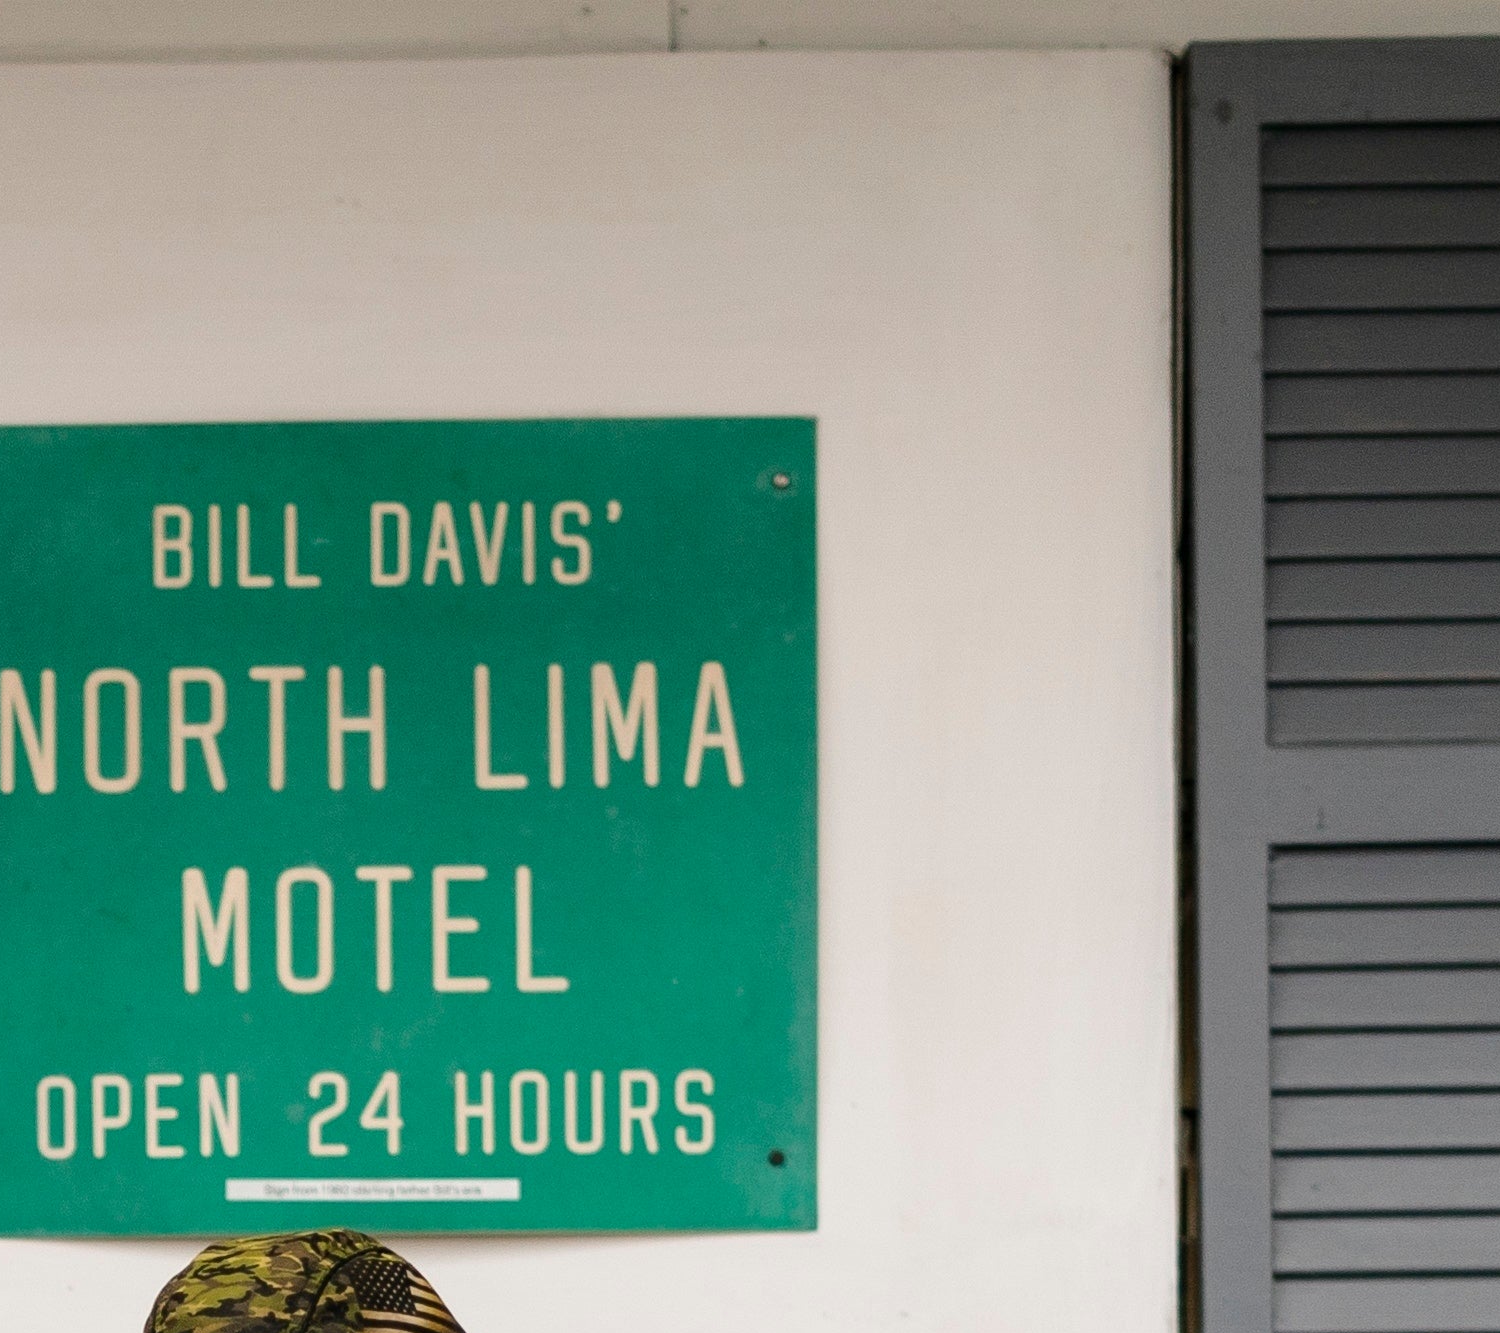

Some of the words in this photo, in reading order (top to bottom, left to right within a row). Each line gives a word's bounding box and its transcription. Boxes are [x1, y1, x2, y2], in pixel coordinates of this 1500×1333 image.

[153, 503, 321, 589] BILL
[370, 500, 622, 587] DAVIS'
[0, 665, 386, 795] NORTH
[474, 661, 744, 790] LIMA
[182, 865, 570, 994] MOTEL
[36, 1072, 240, 1160] OPEN
[308, 1070, 404, 1157] 24
[454, 1069, 715, 1155] HOURS
